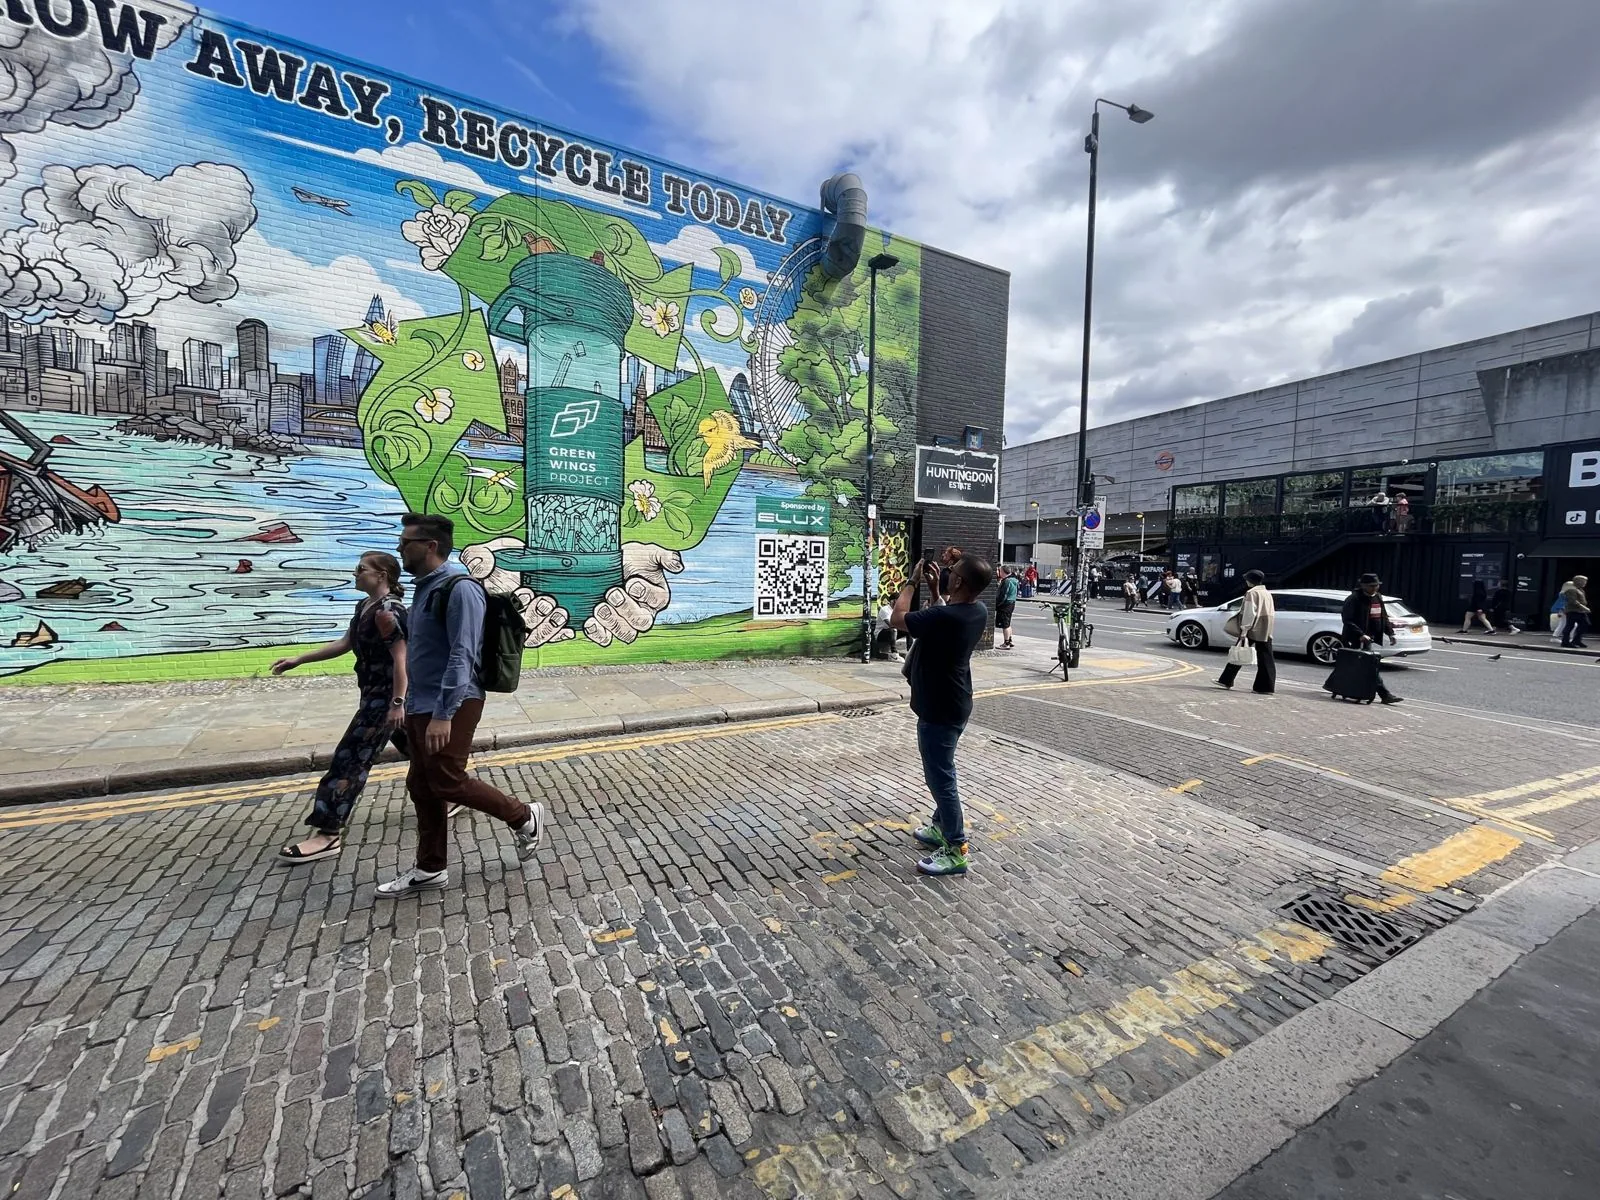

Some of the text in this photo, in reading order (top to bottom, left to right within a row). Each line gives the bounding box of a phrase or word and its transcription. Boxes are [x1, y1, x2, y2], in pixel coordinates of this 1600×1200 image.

[186, 29, 402, 142] AWAY,
[420, 97, 650, 204] RECYCLE
[664, 175, 792, 243] TODAY
[549, 447, 596, 460] GREEN
[549, 460, 597, 473] WINGS
[549, 473, 610, 487] PROJECT
[926, 466, 993, 484] HUNTINGDON
[948, 481, 972, 490] ESTATE
[780, 501, 826, 512] Sponsored by
[757, 512, 825, 526] ELUX
[900, 521, 906, 531] 5
